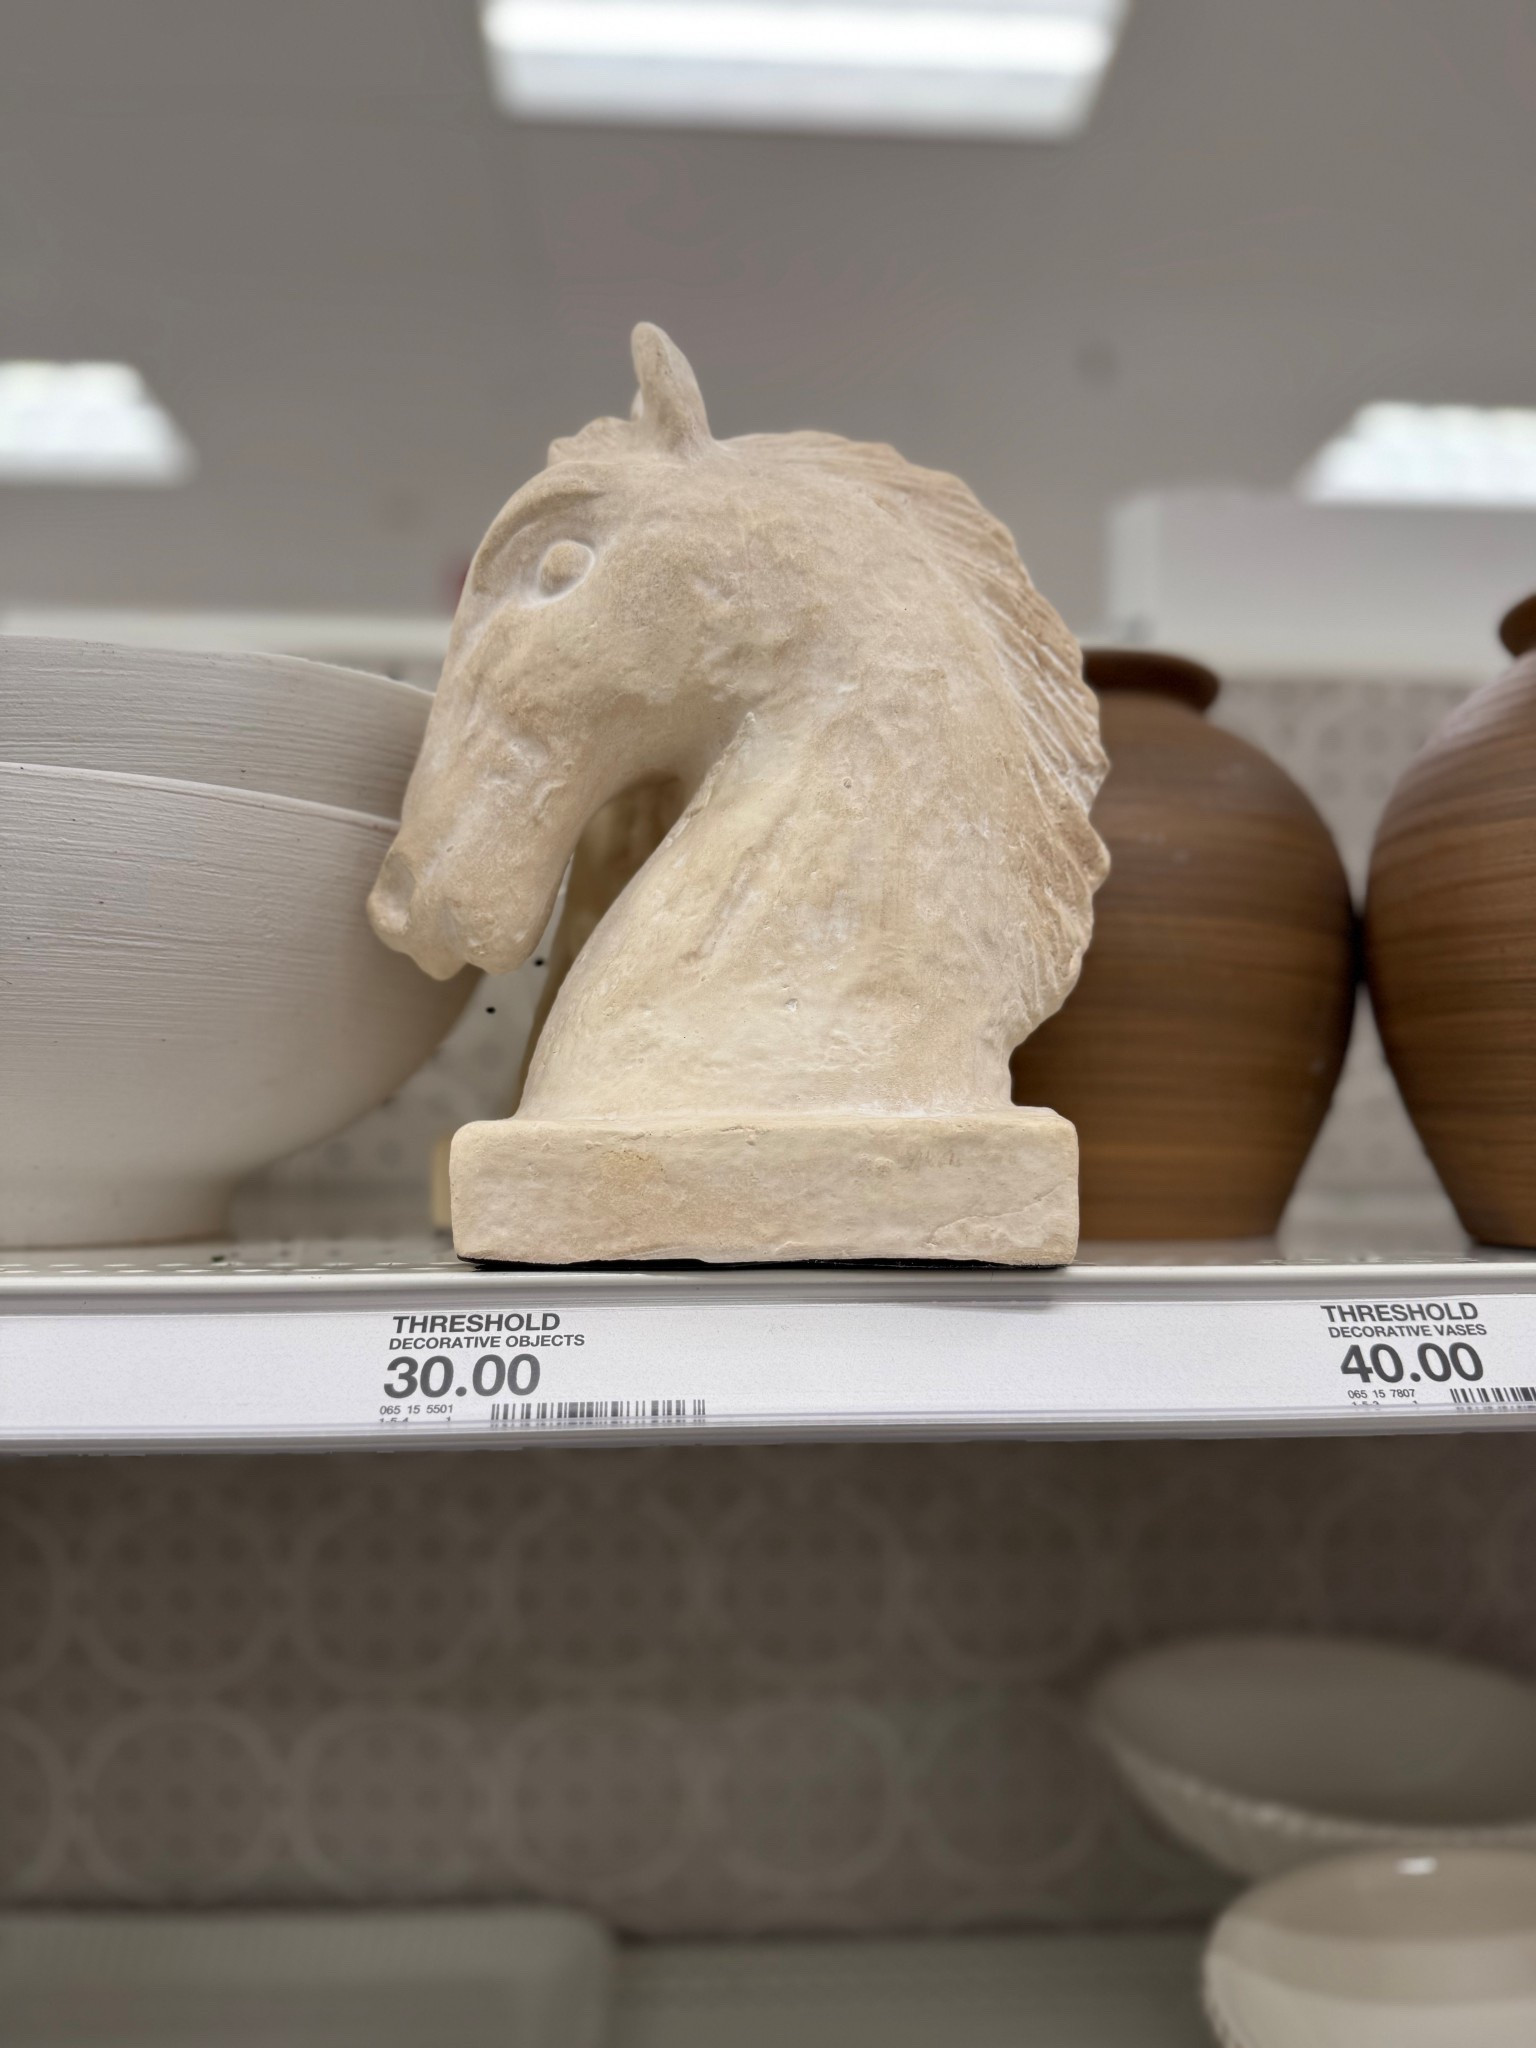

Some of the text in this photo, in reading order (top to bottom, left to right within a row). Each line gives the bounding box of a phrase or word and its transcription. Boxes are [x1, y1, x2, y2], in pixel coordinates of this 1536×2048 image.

[1320, 1302, 1478, 1322] THRESHOLD
[393, 1313, 560, 1333] THRESHOLD
[1328, 1324, 1487, 1338] DECORATIVE VASES
[389, 1334, 585, 1350] DECORATIVE OBJECTS
[1340, 1342, 1483, 1383] 40.00
[384, 1354, 540, 1399] 30.00
[1347, 1389, 1415, 1399] 065 15 7807
[379, 1404, 453, 1415] 065 15 5501
